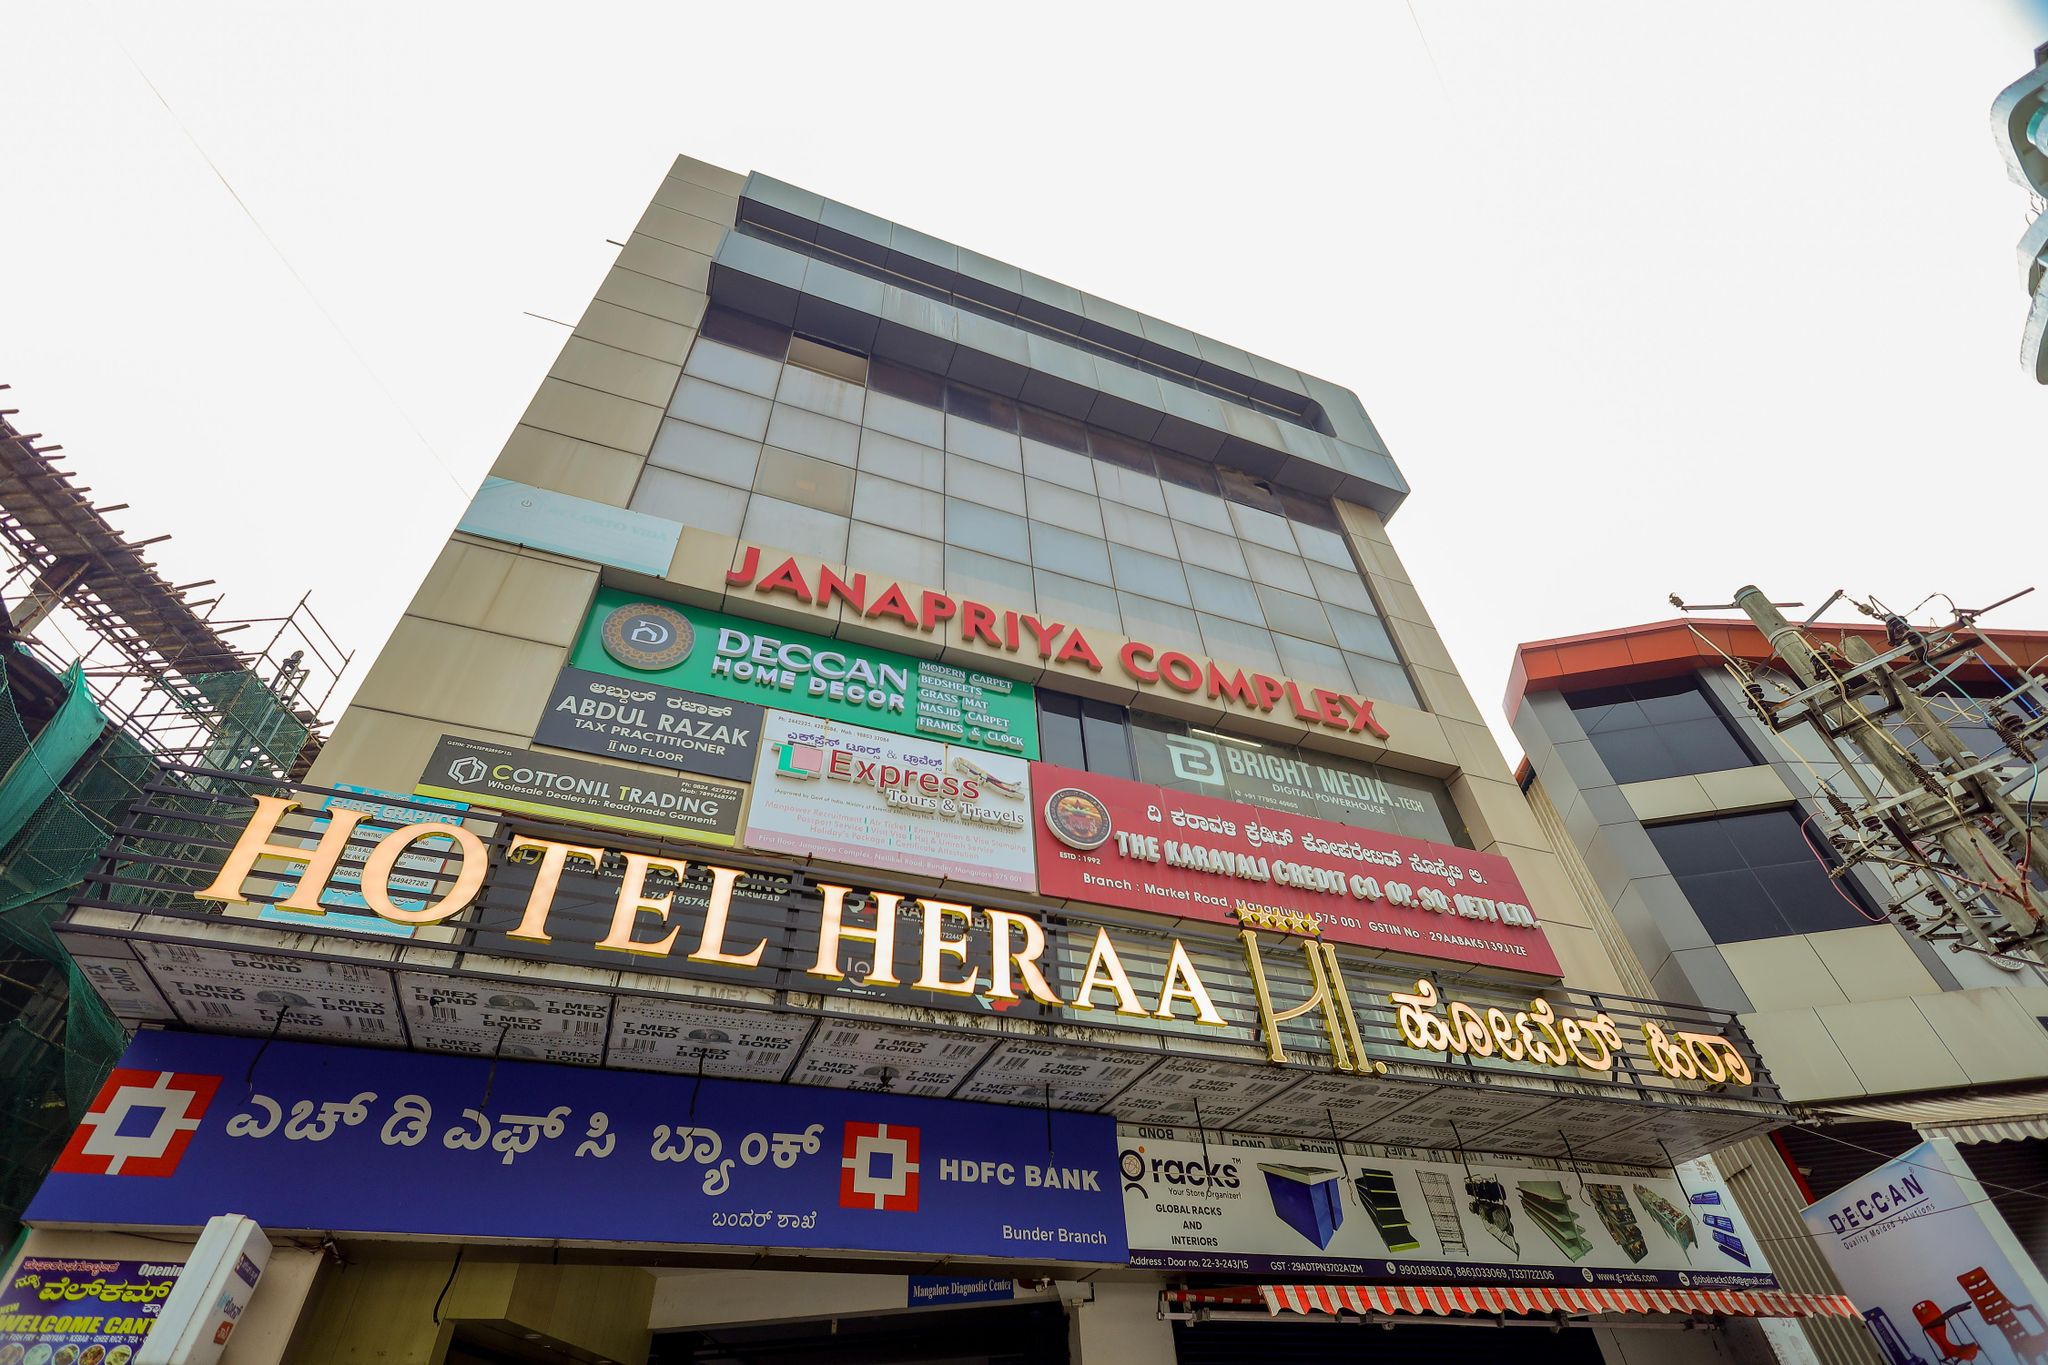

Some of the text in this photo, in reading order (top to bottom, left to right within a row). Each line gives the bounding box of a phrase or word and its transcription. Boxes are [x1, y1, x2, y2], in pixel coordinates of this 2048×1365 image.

[725, 546, 1390, 740] JANAPRIYA COMPLEX
[715, 627, 909, 694] DECCAN
[711, 655, 905, 713] HOME DECOR
[919, 661, 1013, 692] MODERN CARPET
[920, 676, 982, 696] BEDSHEETS
[589, 682, 733, 718] ಅಬ್ದುಲ್ ರಜಾಕ್
[920, 690, 989, 710] GRASS MAT
[555, 695, 750, 747] ABDUL RAZAK
[919, 703, 1010, 728] MASJID CARPET
[575, 718, 726, 756] TAX PRACTITIONER
[919, 717, 1024, 747] FRAMES & CLOCK
[640, 747, 684, 763] FLOOR
[886, 749, 897, 760] &
[828, 749, 980, 800] Express
[1225, 746, 1313, 789] BRIGHT
[492, 764, 611, 798] COTTONIL
[619, 785, 719, 816] TRADING
[692, 783, 709, 791] 0824
[487, 779, 717, 826] Wholesale Dealers in: Readymade Garments
[887, 788, 936, 810] Tours
[942, 798, 956, 813] &
[961, 802, 1025, 825] Travels
[1272, 783, 1313, 801] DIGITAL
[1315, 793, 1386, 815] POWERHOUSE
[1146, 803, 1162, 823] ದಿ
[1170, 807, 1237, 837] ಕರಾವಳಿ
[1244, 821, 1295, 849] ಕ್ರೆಡಿಟ್
[1059, 851, 1101, 865] ESTD 1992
[1113, 830, 1162, 863] THE
[1163, 839, 1272, 883] KARAVALI
[1271, 859, 1348, 897] CREDIT
[194, 794, 1229, 1027] HOTEL HERAA
[1083, 872, 1132, 891] Branch
[1143, 883, 1190, 901] Market
[1193, 892, 1233, 909] Road,
[1314, 912, 1338, 925] 575
[1340, 917, 1362, 929] 001
[1368, 921, 1402, 936] GSTIN
[1404, 927, 1420, 939] No
[178, 988, 246, 1002] BOND
[415, 994, 478, 1006] BOND
[548, 1007, 605, 1019] BOND
[483, 1020, 541, 1031] BOND
[623, 1028, 678, 1039] BOND
[1388, 978, 1753, 1087] ಹೋಟೆಲ್ ಹಿರಾ
[737, 1039, 790, 1050] BOND
[874, 1043, 923, 1054] BOND
[906, 1075, 953, 1084] BOND
[1038, 1067, 1084, 1077] BOND
[650, 1123, 825, 1196] ಬ್ಯಾಂಕ್
[939, 1158, 1102, 1192] HDFC BANK
[1168, 1187, 1184, 1197] Your
[1185, 1188, 1205, 1198] Store
[1155, 1204, 1223, 1217] GLOBAL RACKS
[1828, 1174, 1924, 1235] DECCAN
[711, 1208, 818, 1230] ಬಂದರ್ ಶಾಖೆ
[1182, 1219, 1203, 1231] AND
[1843, 1233, 1870, 1250] Quality
[1869, 1219, 1896, 1238] Molded
[1898, 1203, 1936, 1225] Solutions
[1002, 1225, 1107, 1245] Bunder Branch
[1170, 1235, 1219, 1247] INTERIORS
[1129, 1256, 1249, 1270] Address Door no. 22-3-243/15
[1270, 1262, 1286, 1271] GST
[1596, 1272, 1659, 1284] www.g-racks.com
[913, 1279, 1012, 1299] Mangalore Diagnostic Center
[0, 1315, 104, 1334] WELCOME
